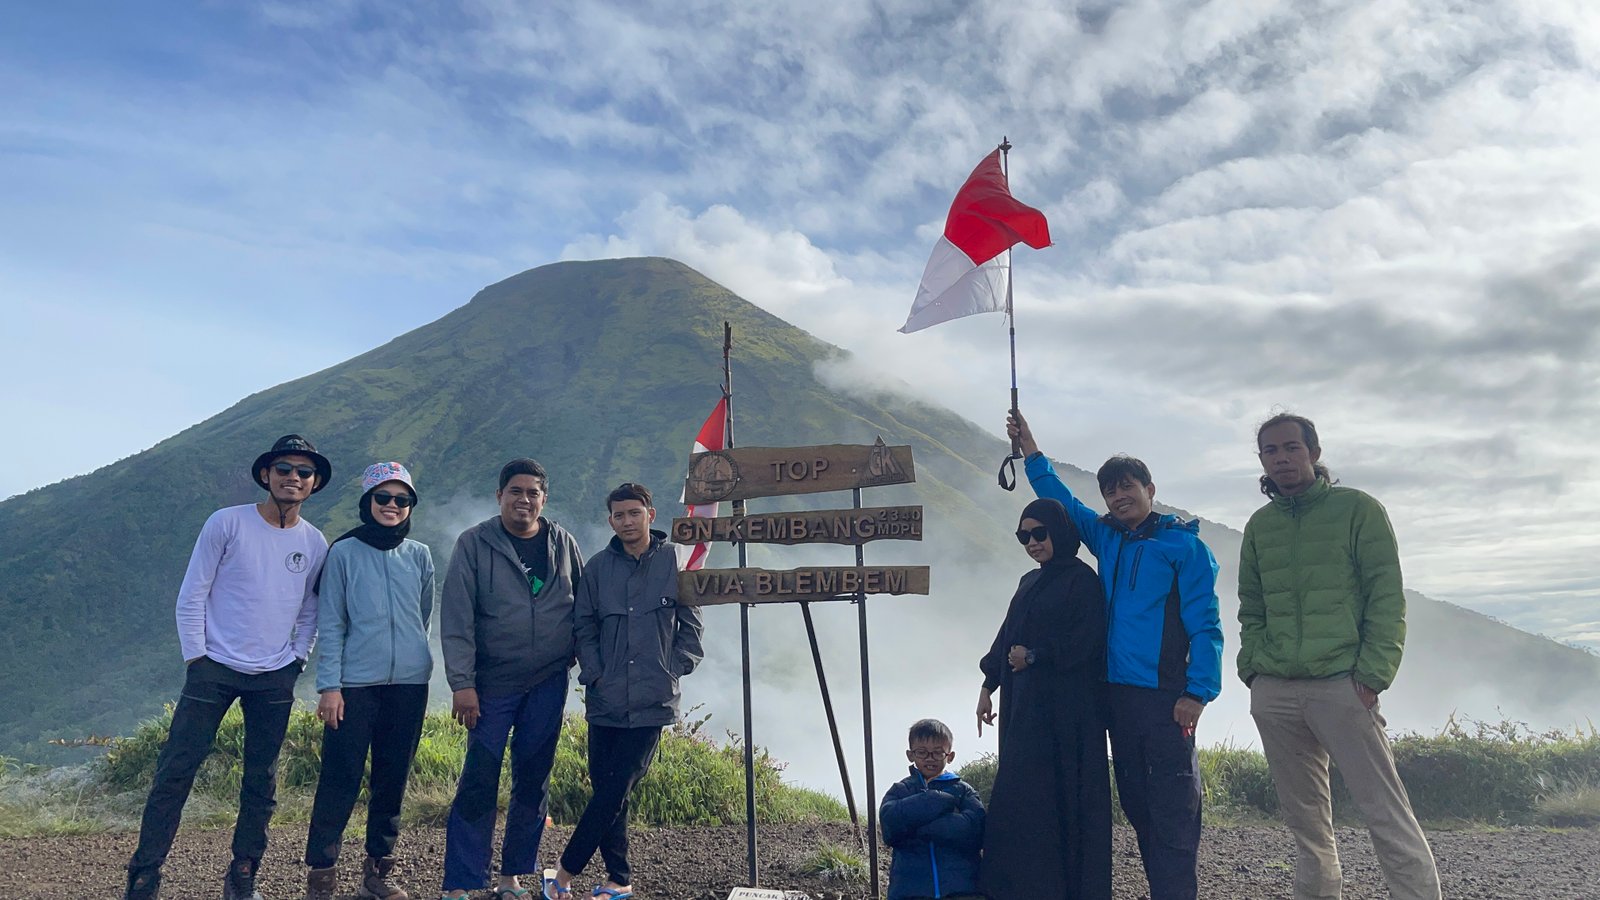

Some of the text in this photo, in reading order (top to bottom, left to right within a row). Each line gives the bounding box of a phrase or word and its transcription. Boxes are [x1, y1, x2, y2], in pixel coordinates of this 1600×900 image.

[770, 460, 829, 482] TOP
[877, 509, 920, 521] 2340
[673, 513, 875, 540] GN KEMBANG
[877, 523, 920, 536] MDPL
[693, 570, 906, 595] VIA BLEMBEM
